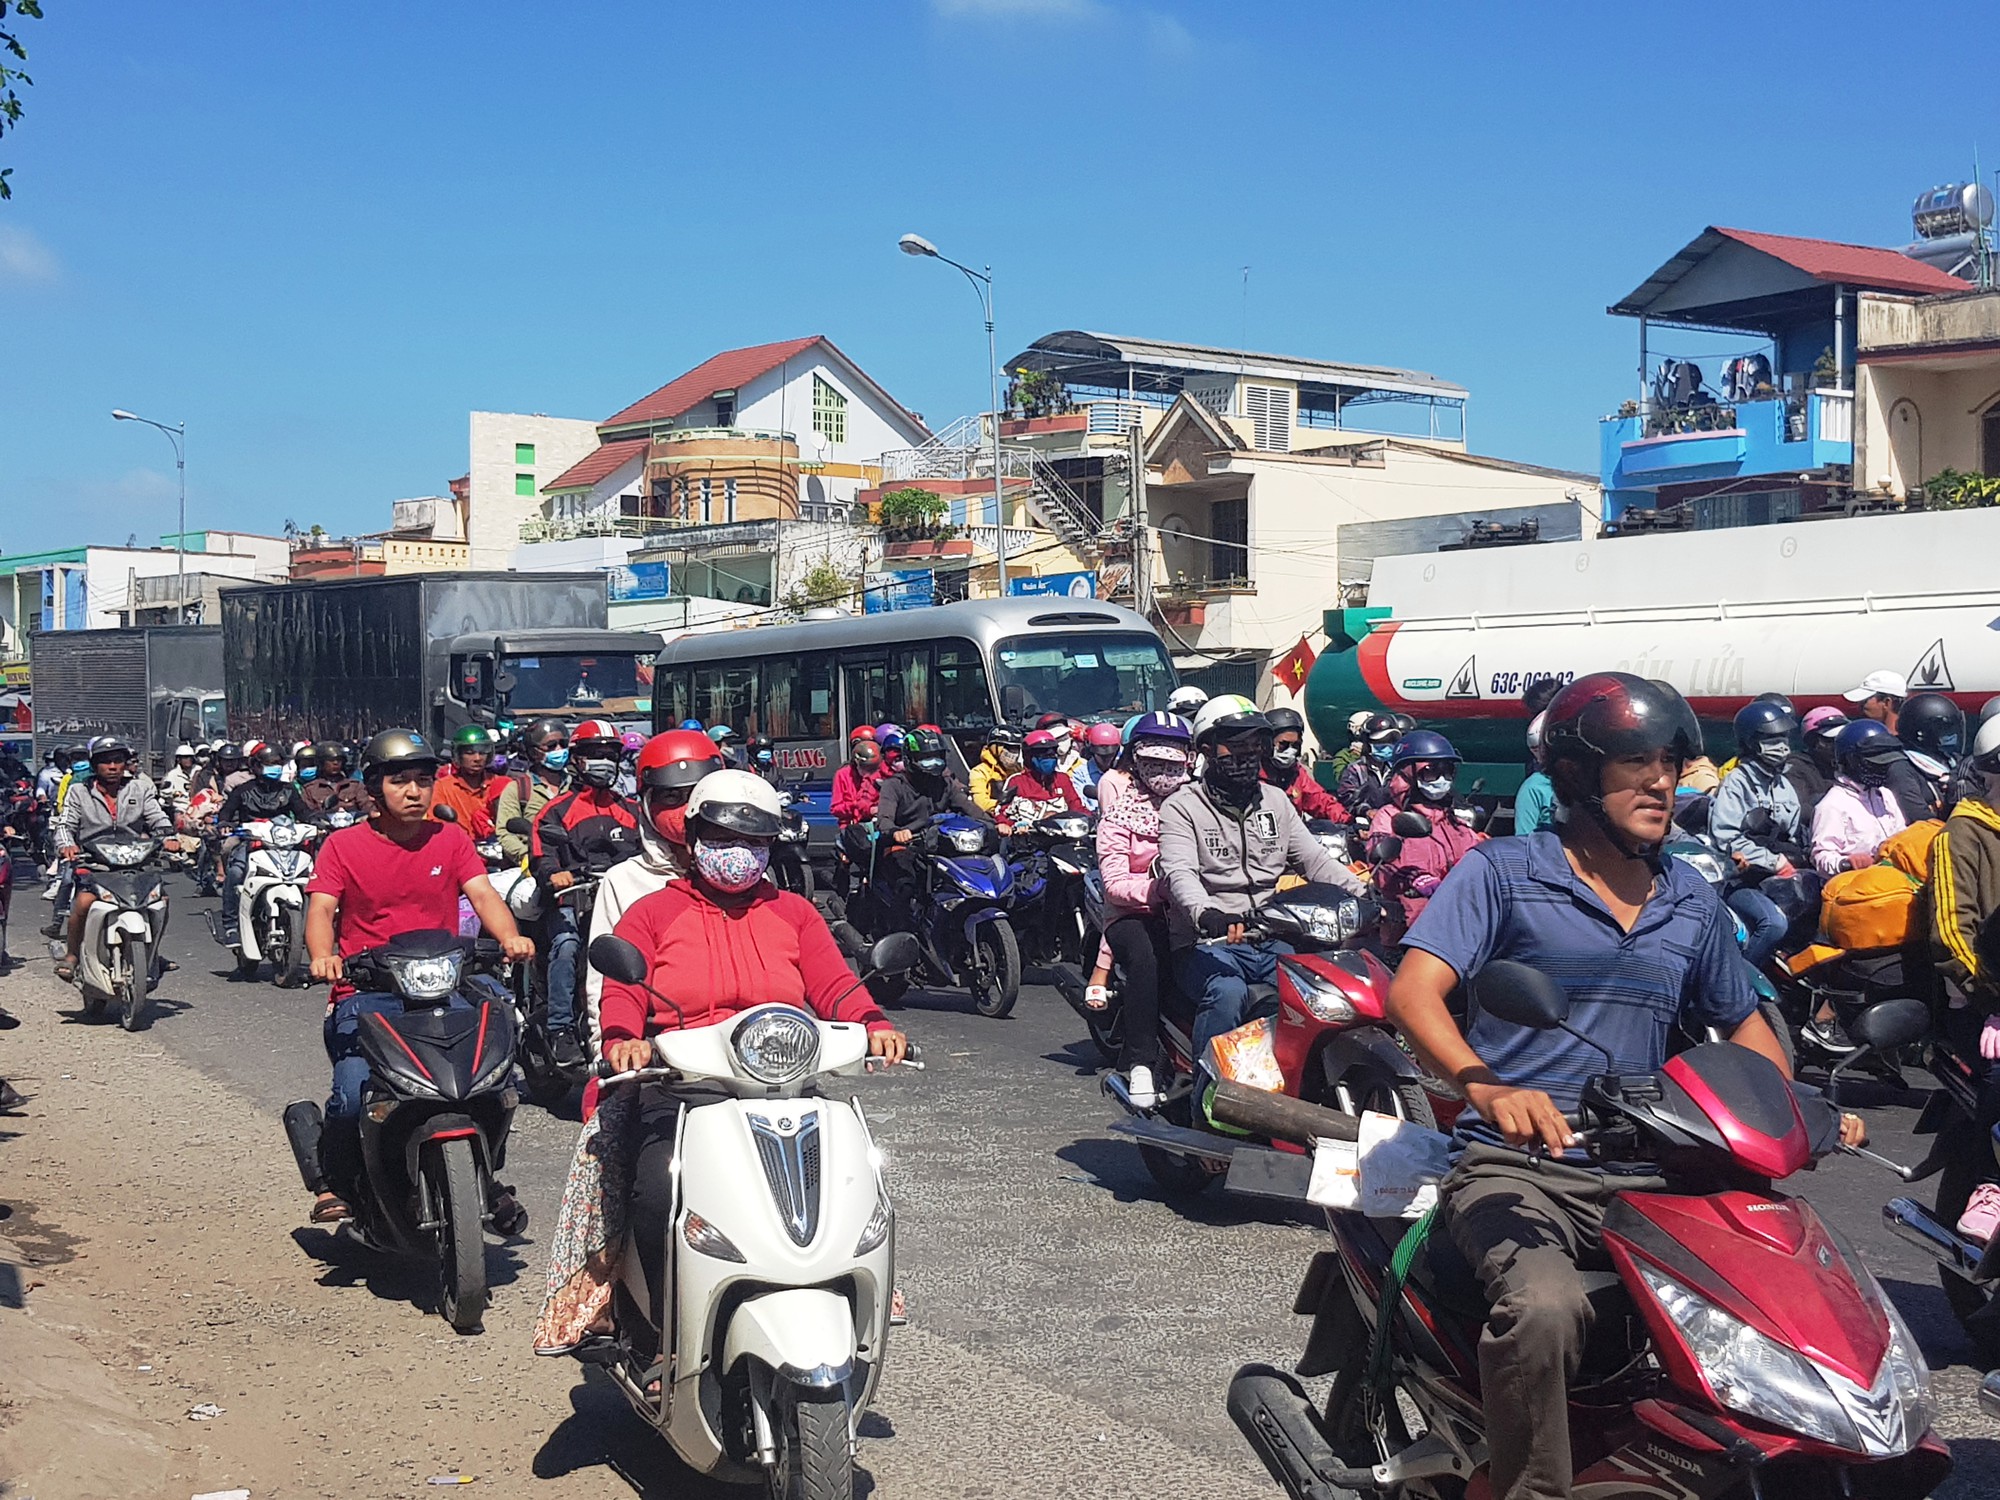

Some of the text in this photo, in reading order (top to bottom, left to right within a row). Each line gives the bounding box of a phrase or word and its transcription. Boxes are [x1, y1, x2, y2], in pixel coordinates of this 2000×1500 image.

[1689, 643, 1745, 694] LỬA
[1746, 1204, 1790, 1213] HONDA
[1646, 1442, 1705, 1477] HONDA
